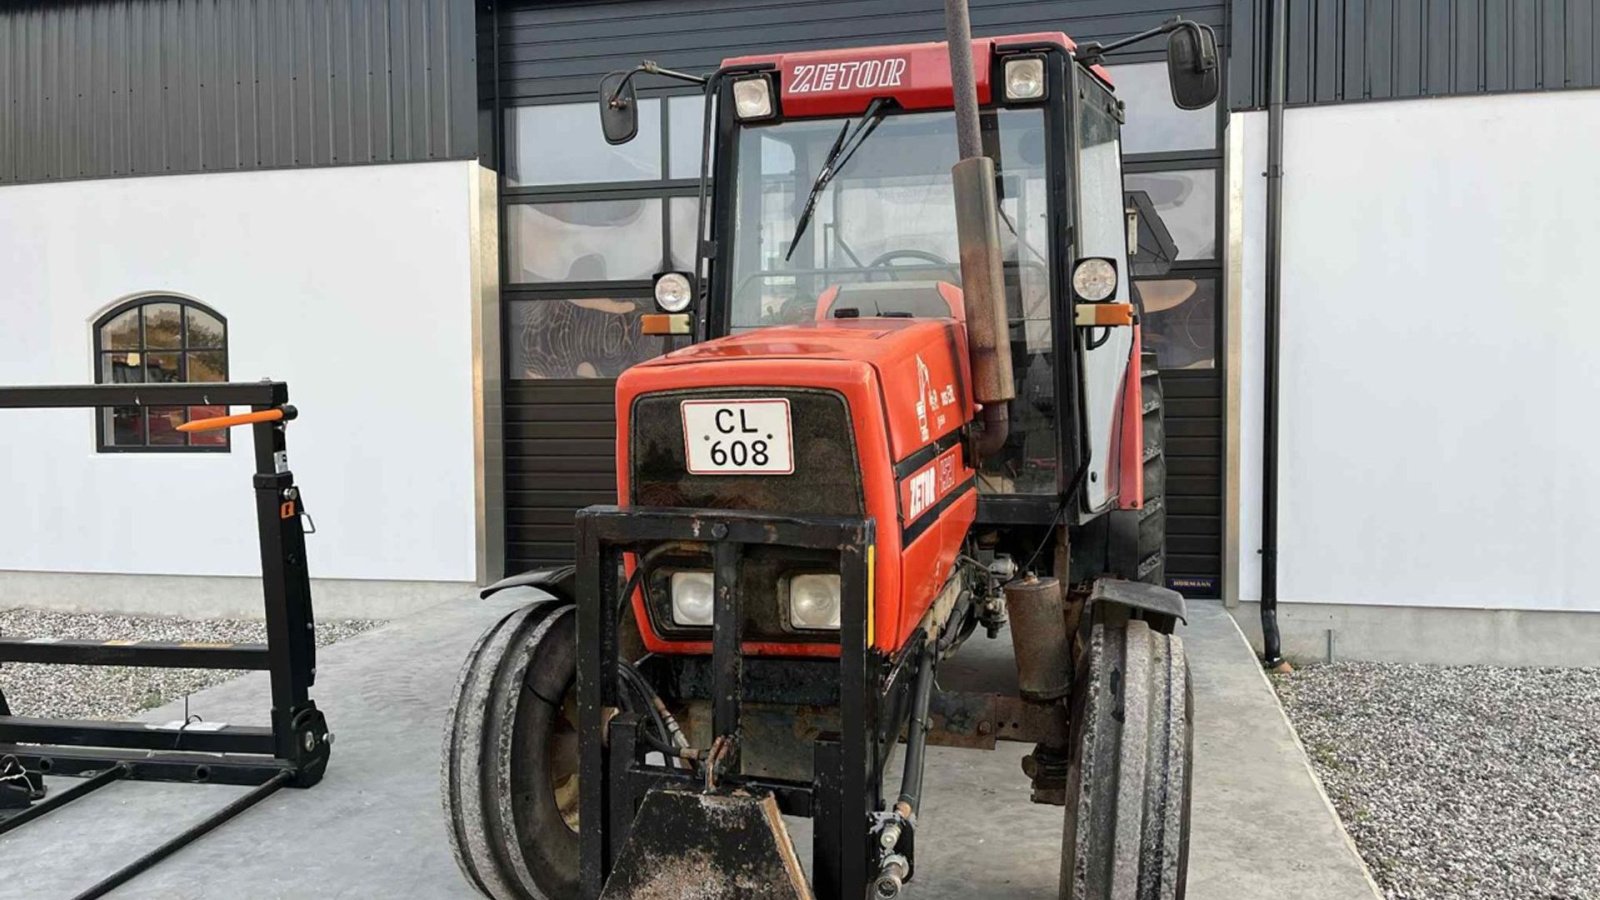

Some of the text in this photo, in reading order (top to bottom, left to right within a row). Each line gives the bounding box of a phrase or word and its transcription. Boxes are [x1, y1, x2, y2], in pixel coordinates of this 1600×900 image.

[788, 58, 906, 93] ZETOR
[715, 408, 758, 434] CL
[710, 440, 769, 467] 608
[909, 466, 936, 520] ZETOR
